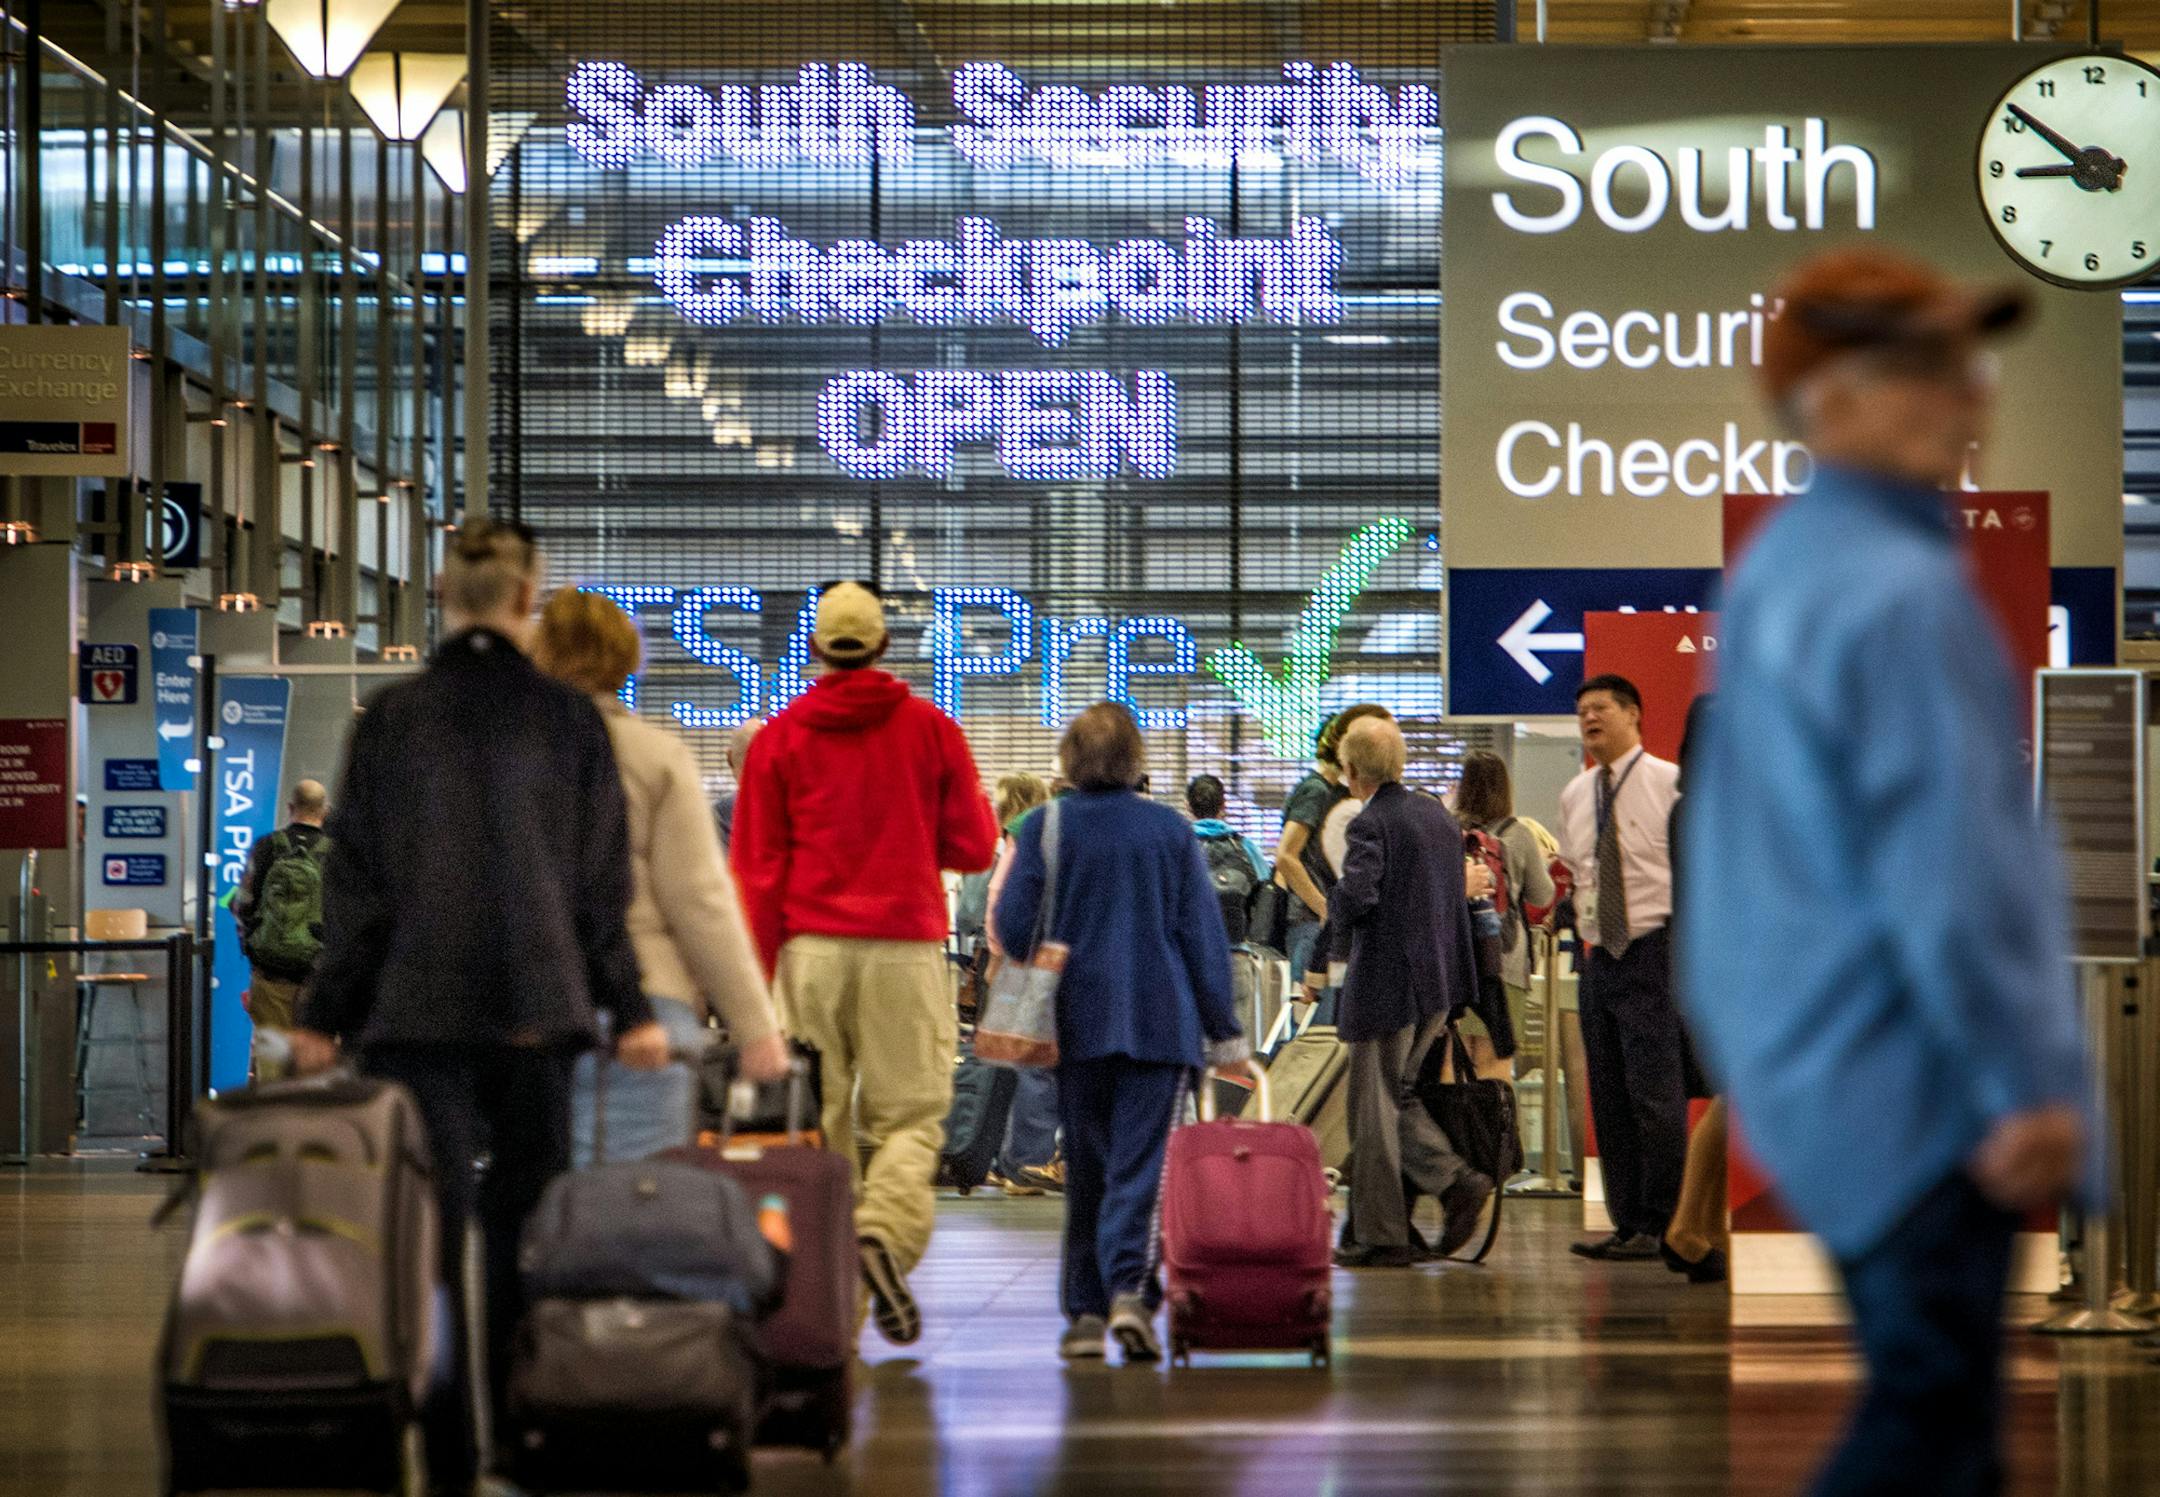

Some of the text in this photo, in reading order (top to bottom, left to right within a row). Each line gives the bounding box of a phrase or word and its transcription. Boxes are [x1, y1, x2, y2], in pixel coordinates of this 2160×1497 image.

[2083, 66, 2106, 84] 12
[2036, 79, 2055, 97] 11
[2136, 80, 2147, 98] 1
[564, 60, 1440, 192] South Security
[1491, 114, 1876, 234] South
[1990, 160, 2003, 178] 9
[2002, 205, 2017, 223] 8
[2040, 240, 2053, 258] 7
[2131, 241, 2146, 259] 5
[2084, 253, 2099, 271] 6
[652, 213, 1346, 349] Checkpoint
[1495, 290, 1786, 370] Securi
[816, 368, 1179, 480] OPEN
[91, 646, 126, 664] AED
[933, 585, 1198, 728] Pre
[156, 671, 193, 689] Enter
[157, 688, 191, 705] Here
[223, 748, 255, 817] TSA
